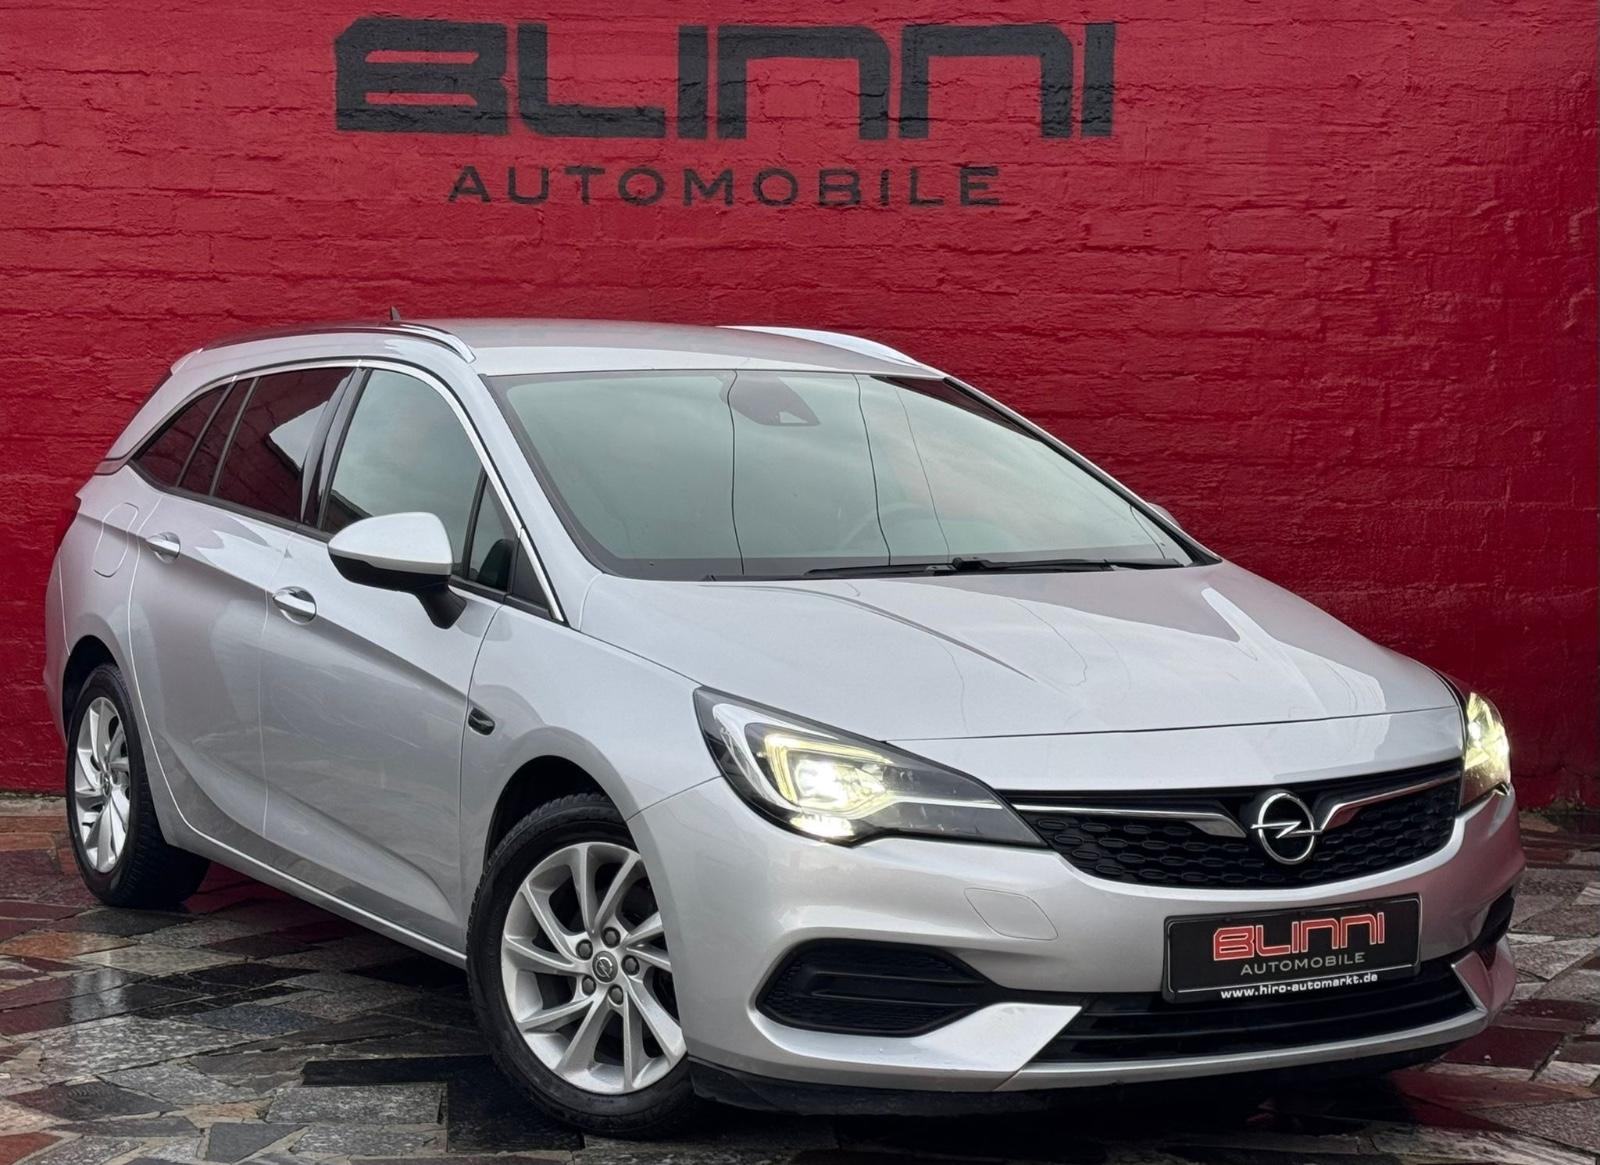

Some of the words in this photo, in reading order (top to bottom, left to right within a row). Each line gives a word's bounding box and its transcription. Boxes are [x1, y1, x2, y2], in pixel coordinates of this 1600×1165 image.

[335, 17, 1115, 140] BLINNI
[450, 165, 1001, 207] AUTOMOBILE
[1213, 912, 1385, 961] BLINNI
[1240, 952, 1365, 976] AUTOMOBILE
[1221, 972, 1378, 999] www.hiro-automarkt.de
